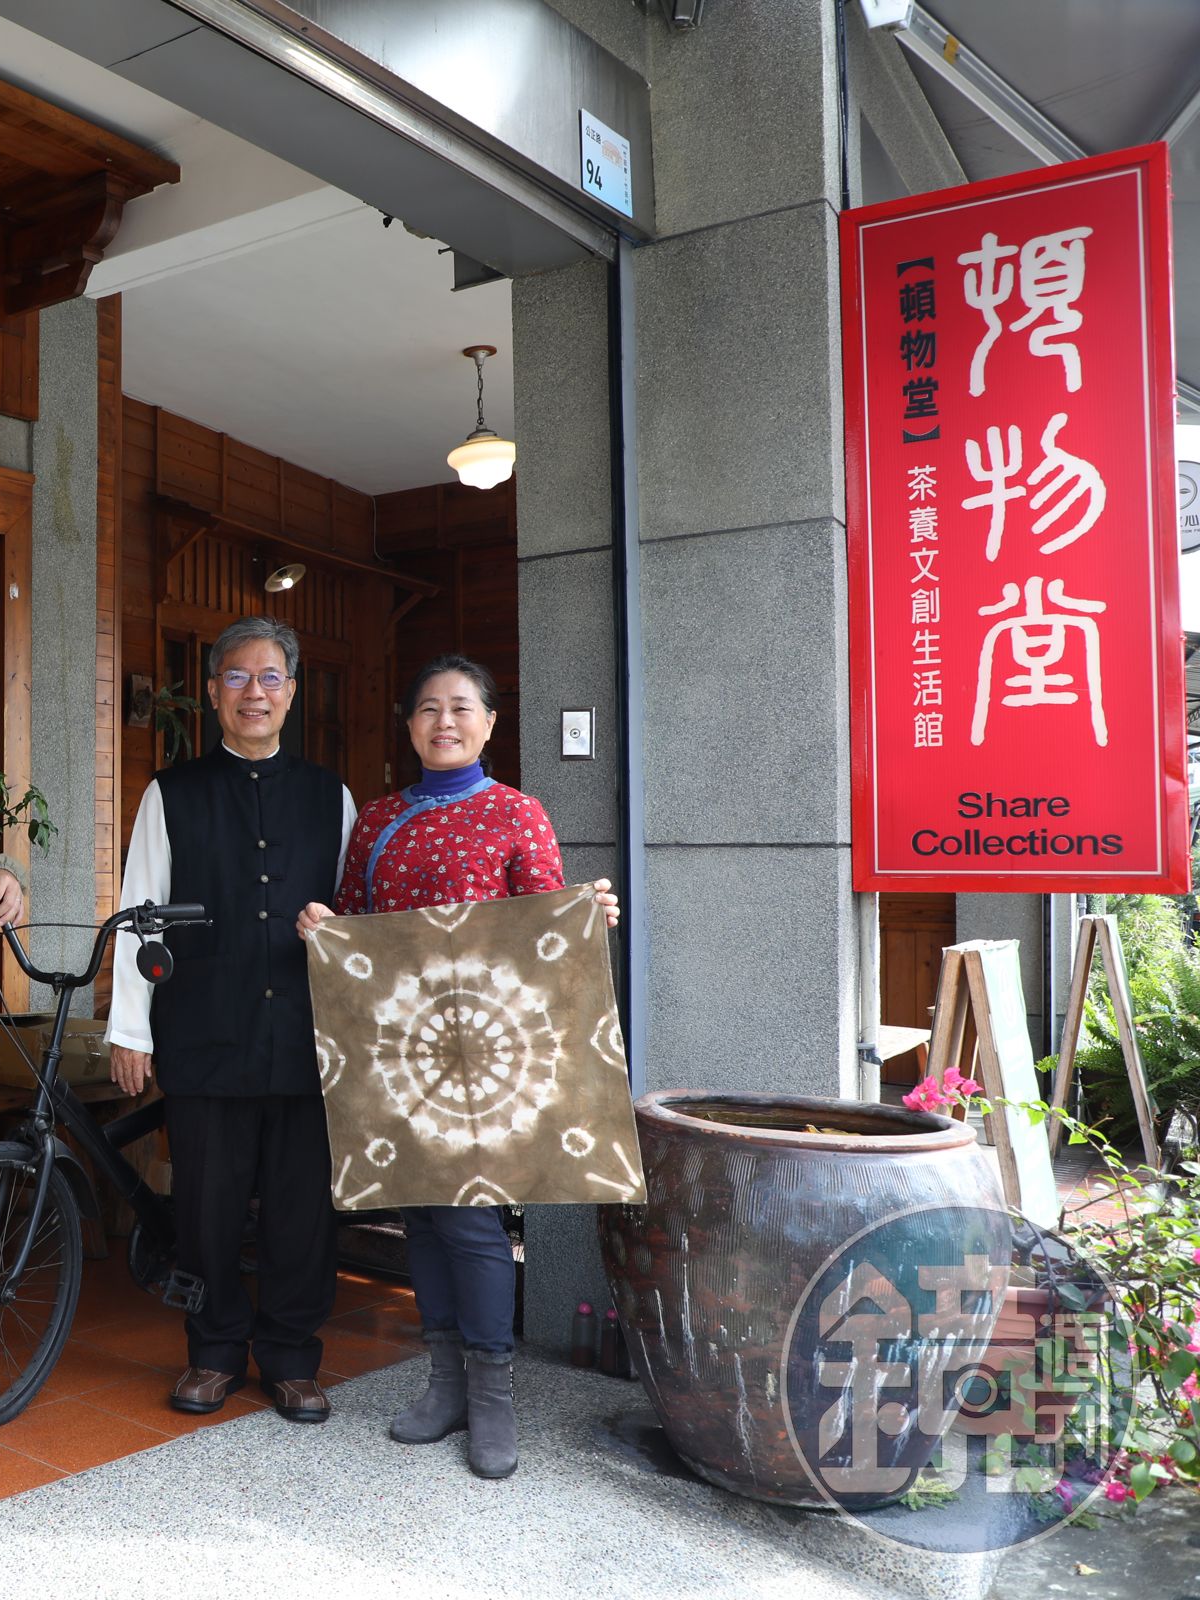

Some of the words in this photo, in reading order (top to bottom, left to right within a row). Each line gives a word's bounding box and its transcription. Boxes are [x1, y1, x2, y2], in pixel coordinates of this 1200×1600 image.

[586, 158, 602, 191] 94
[957, 226, 1109, 748] 頓物堂
[907, 465, 944, 750] 茶養文創生活館
[957, 791, 1070, 819] Share
[910, 827, 1124, 858] Collections
